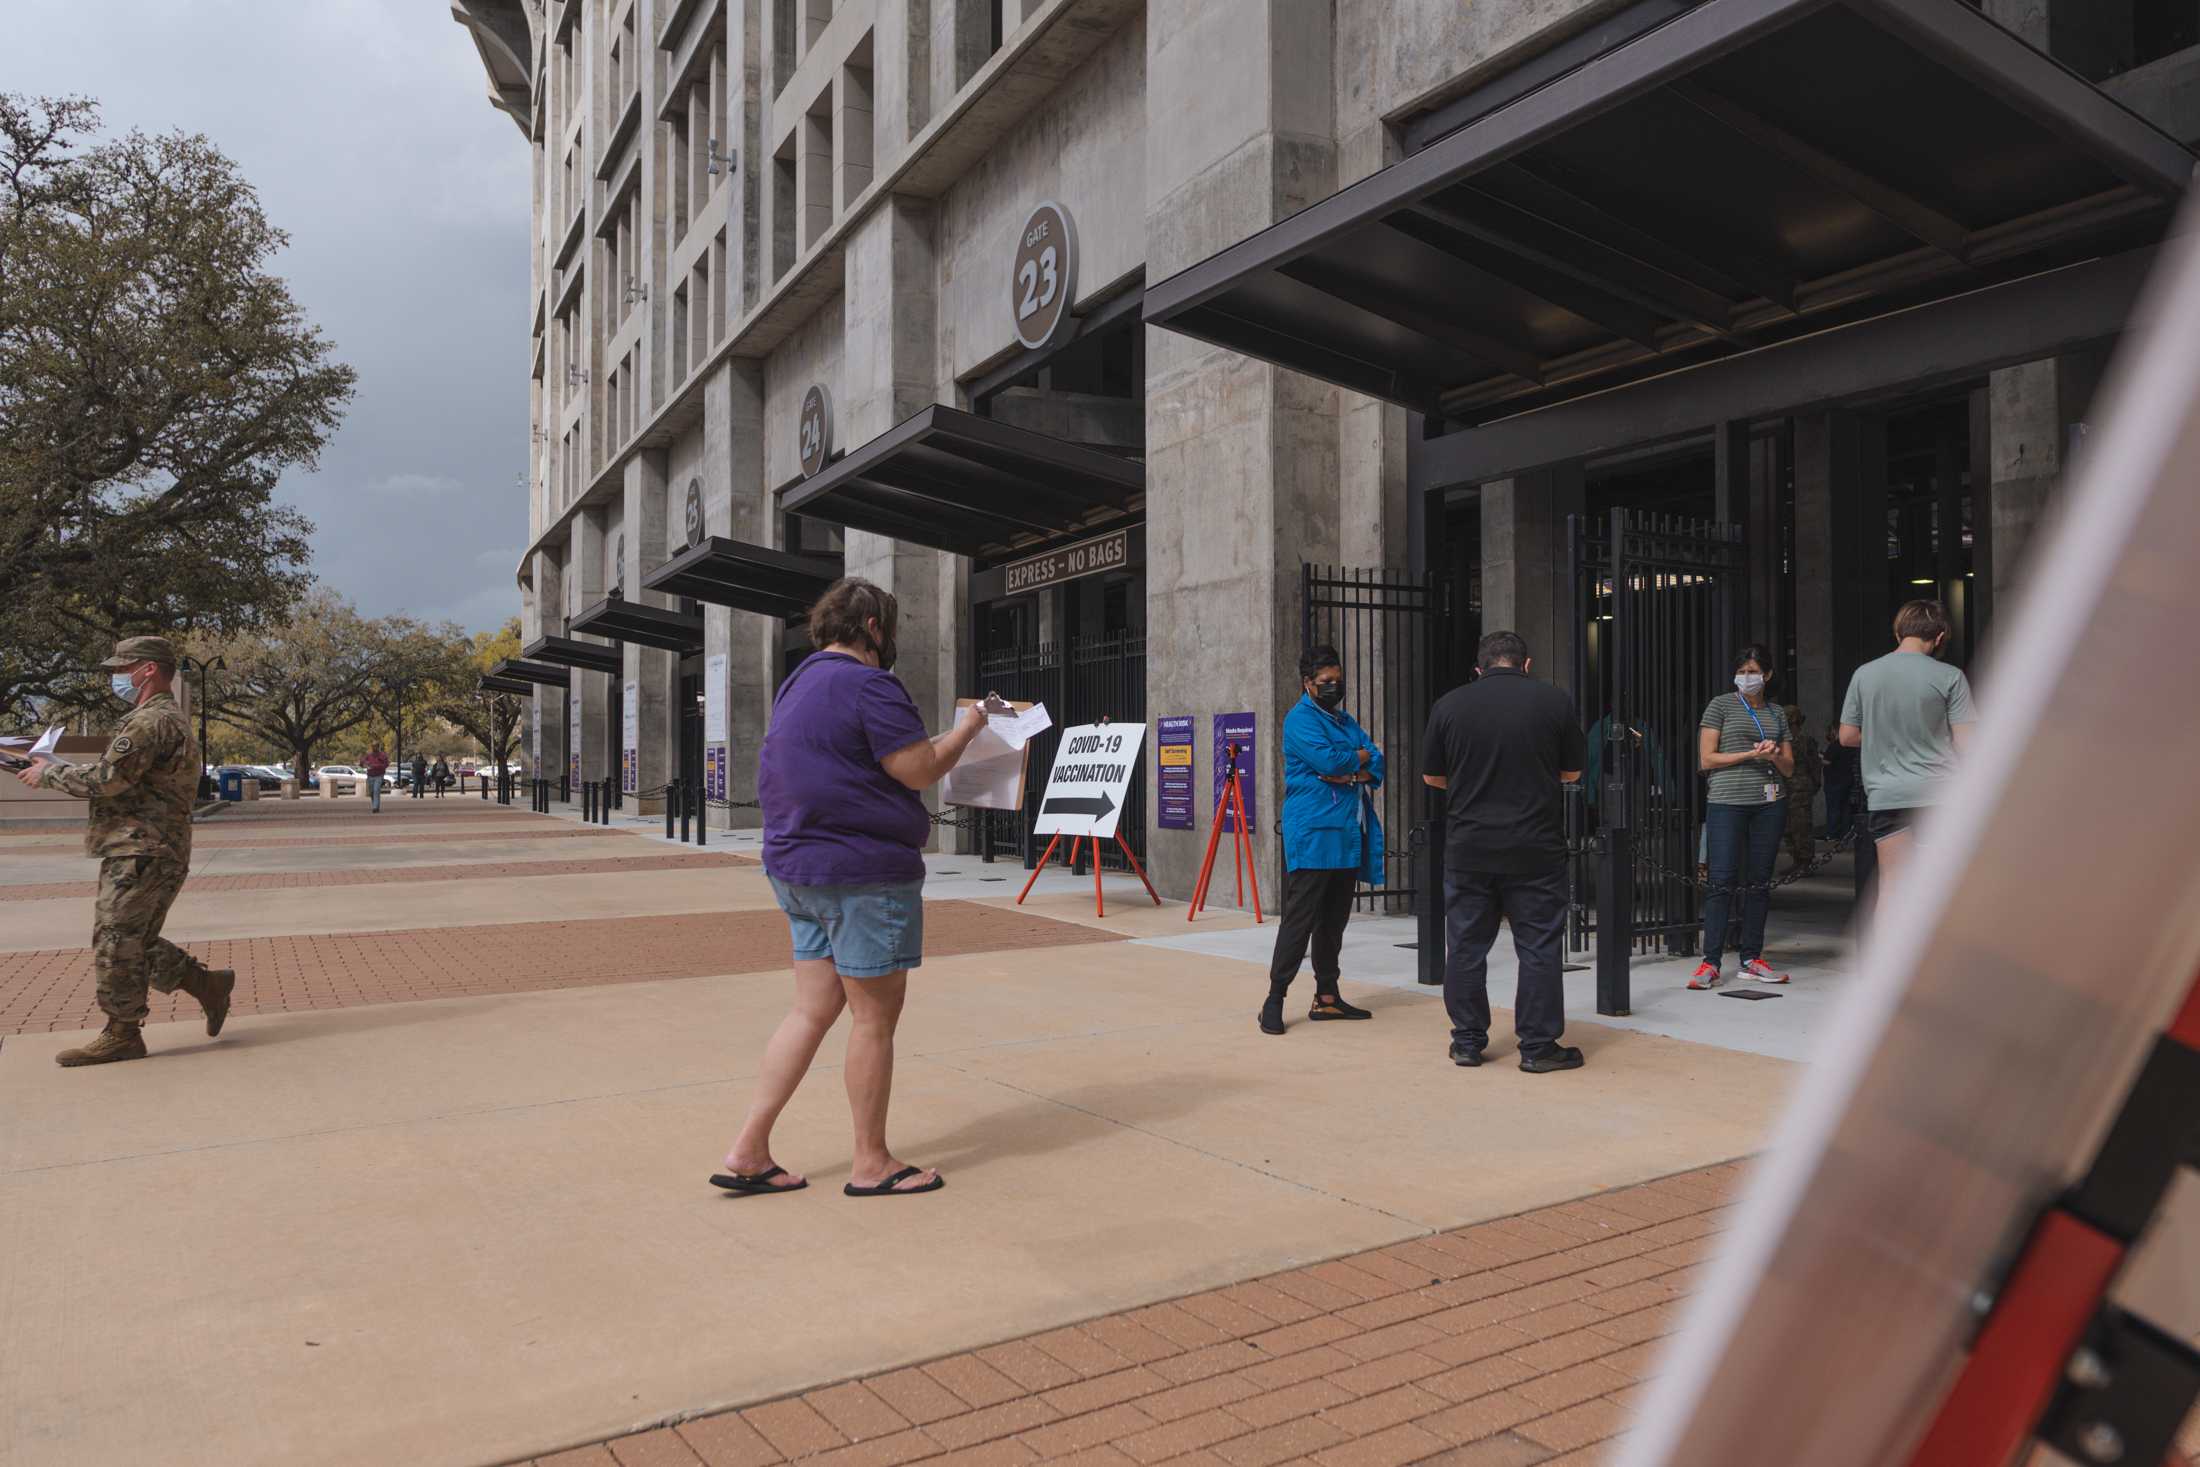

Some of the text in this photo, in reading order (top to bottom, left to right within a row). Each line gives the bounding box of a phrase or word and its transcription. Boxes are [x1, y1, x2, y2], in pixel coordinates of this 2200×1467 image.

[1026, 220, 1049, 247] GATE
[1018, 245, 1057, 321] 23
[802, 413, 820, 460] 24
[1008, 558, 1055, 589] EXPRESS
[1068, 549, 1085, 573] NO
[1089, 538, 1123, 568] BAGS
[1068, 735, 1122, 755] COVID-19
[1052, 763, 1127, 784] VACCINATION
